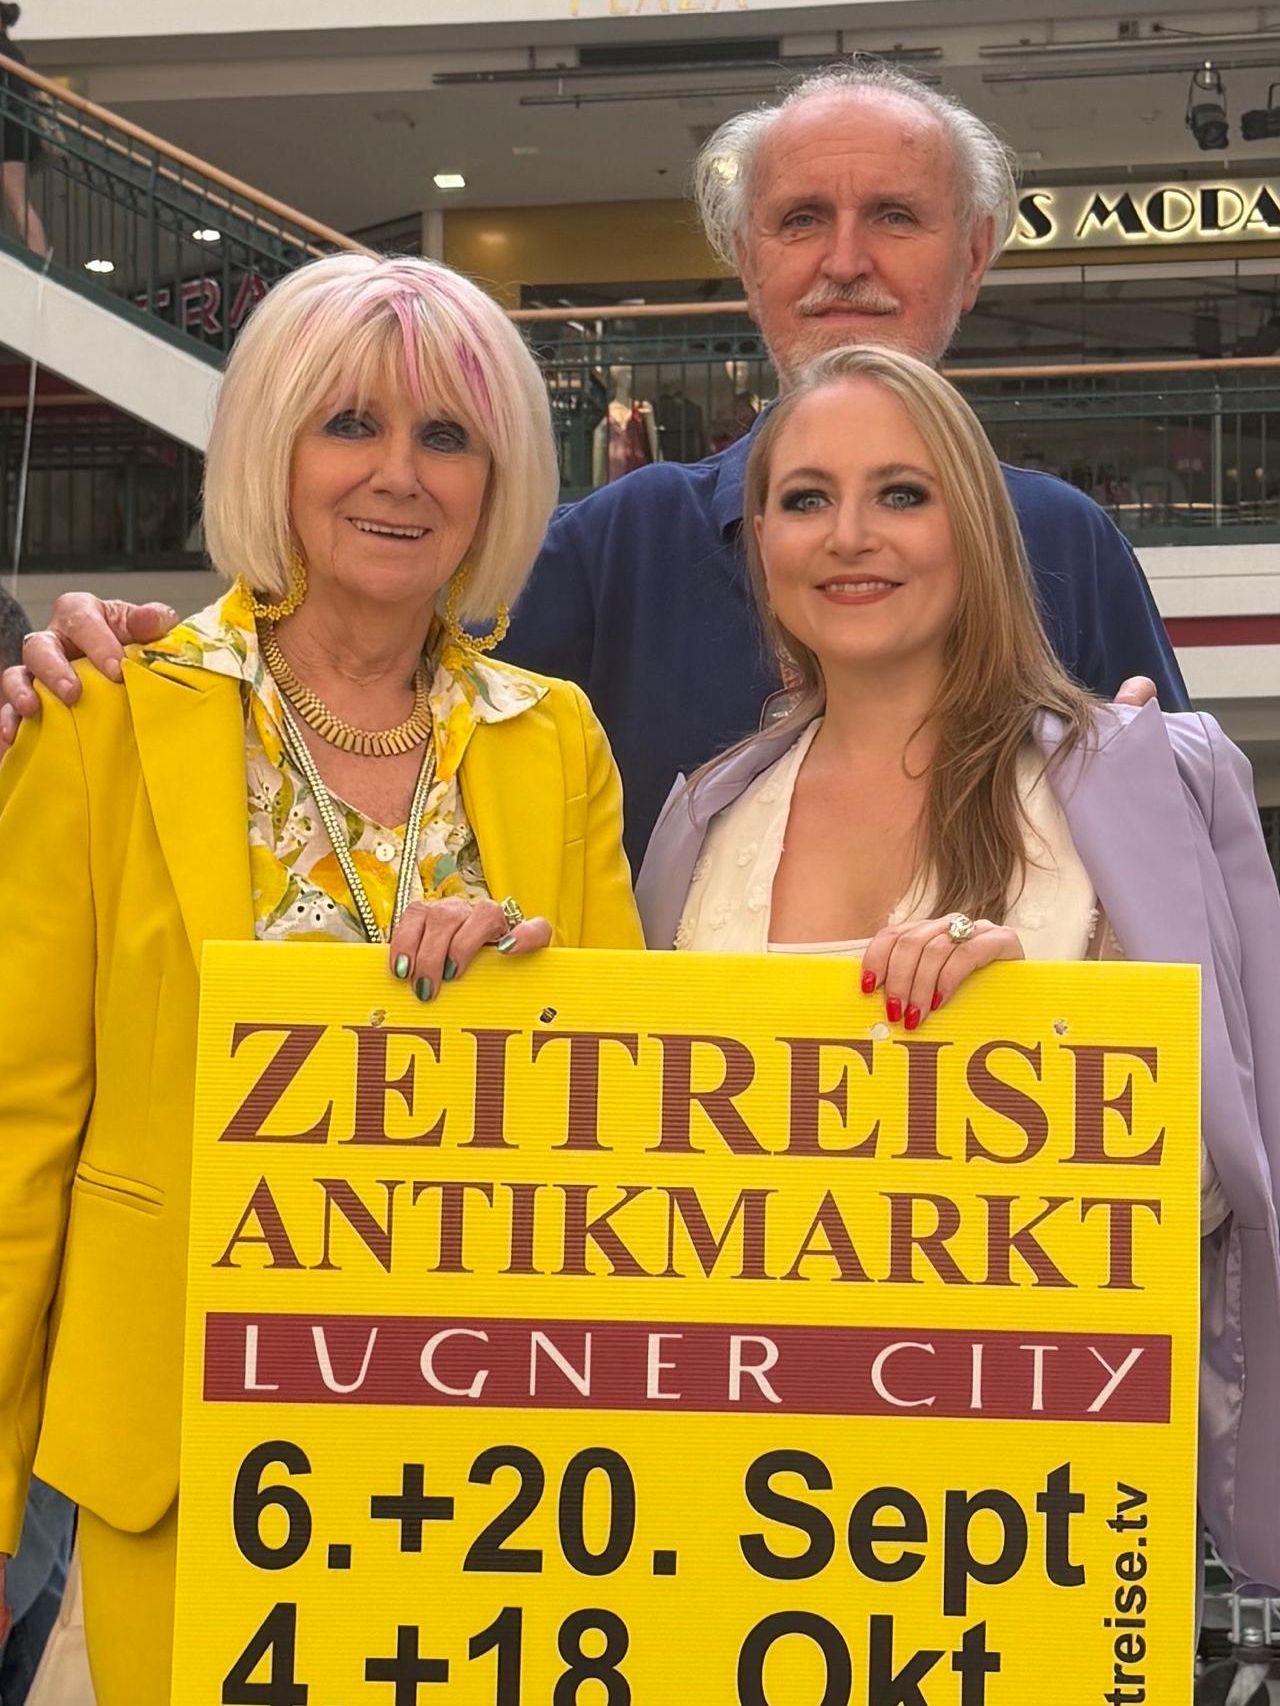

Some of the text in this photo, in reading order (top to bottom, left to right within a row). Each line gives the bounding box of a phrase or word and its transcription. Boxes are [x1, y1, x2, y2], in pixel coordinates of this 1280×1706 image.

[217, 1022, 1166, 1167] ZEITREISE
[211, 1175, 1163, 1291] ANTIKMARKT
[244, 1323, 1146, 1413] LUGNER CITY
[231, 1439, 1087, 1618] 6.+20. Sept
